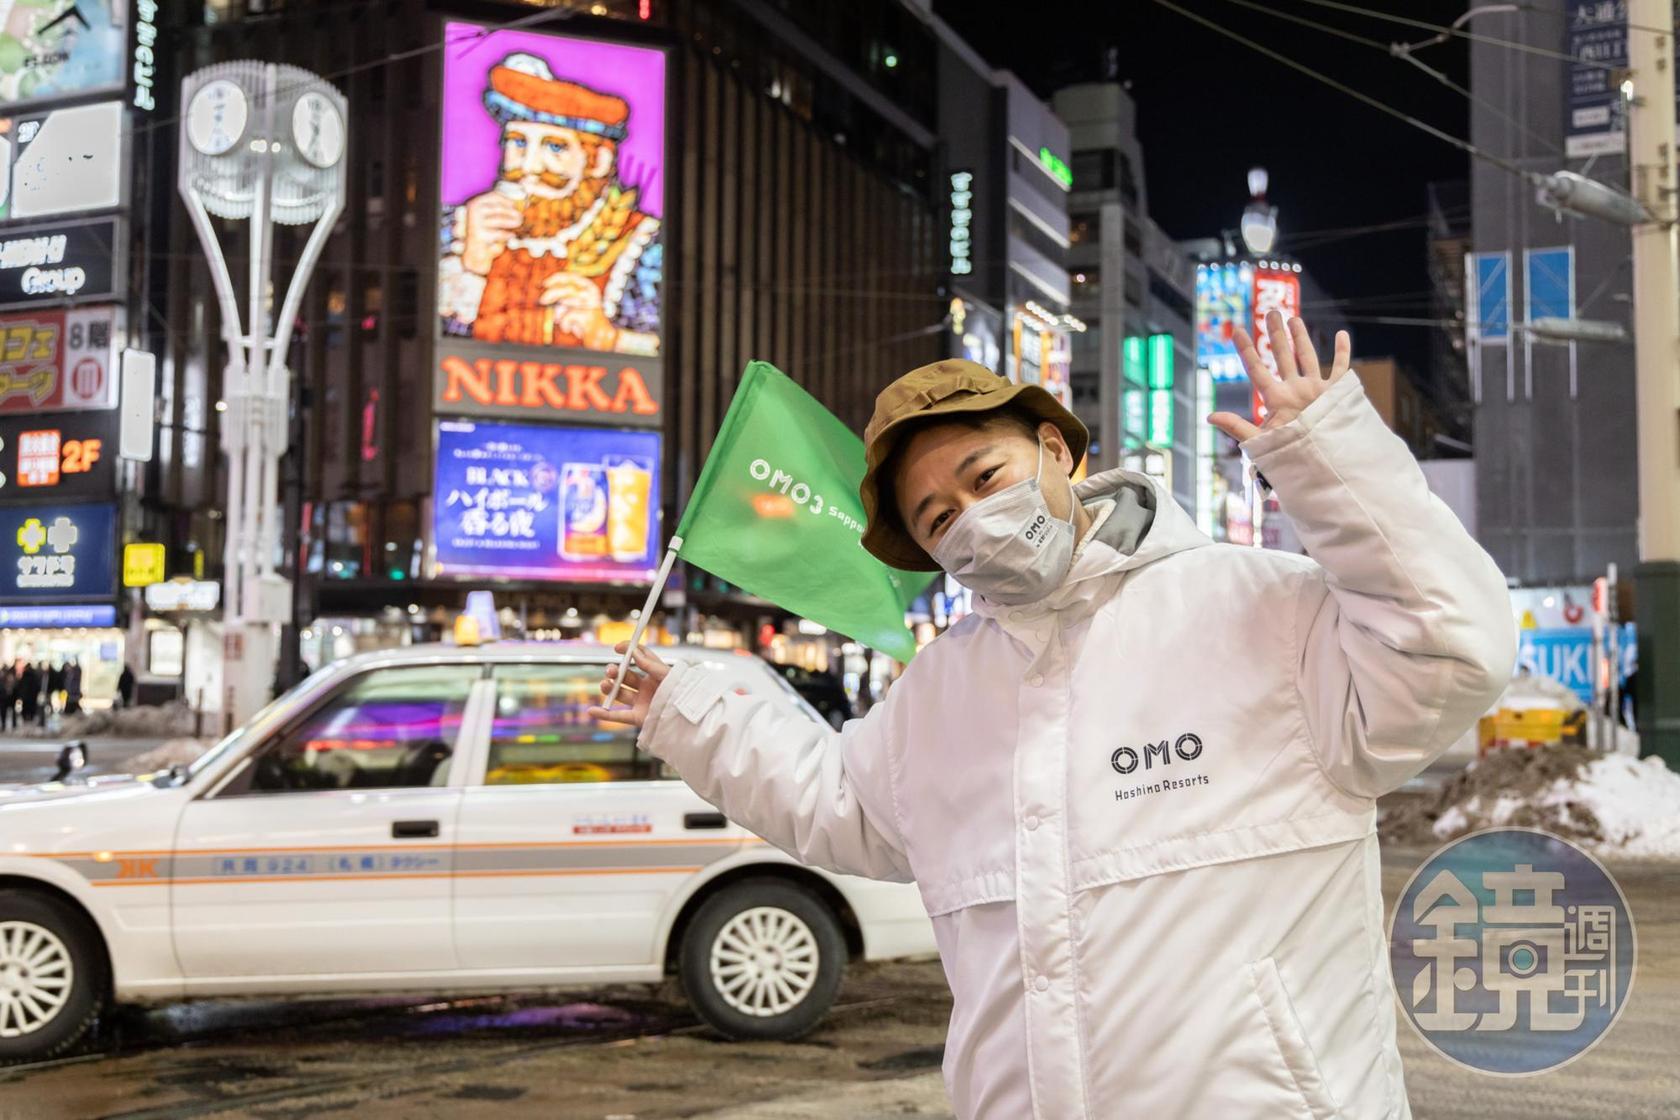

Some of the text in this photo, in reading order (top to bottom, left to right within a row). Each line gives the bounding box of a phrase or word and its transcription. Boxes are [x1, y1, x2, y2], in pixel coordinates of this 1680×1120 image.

[441, 356, 660, 415] NIKKA
[61, 438, 102, 474] 2F
[1025, 514, 1046, 541] OMO
[1110, 732, 1203, 775] OMO
[1162, 774, 1209, 792] Resorts
